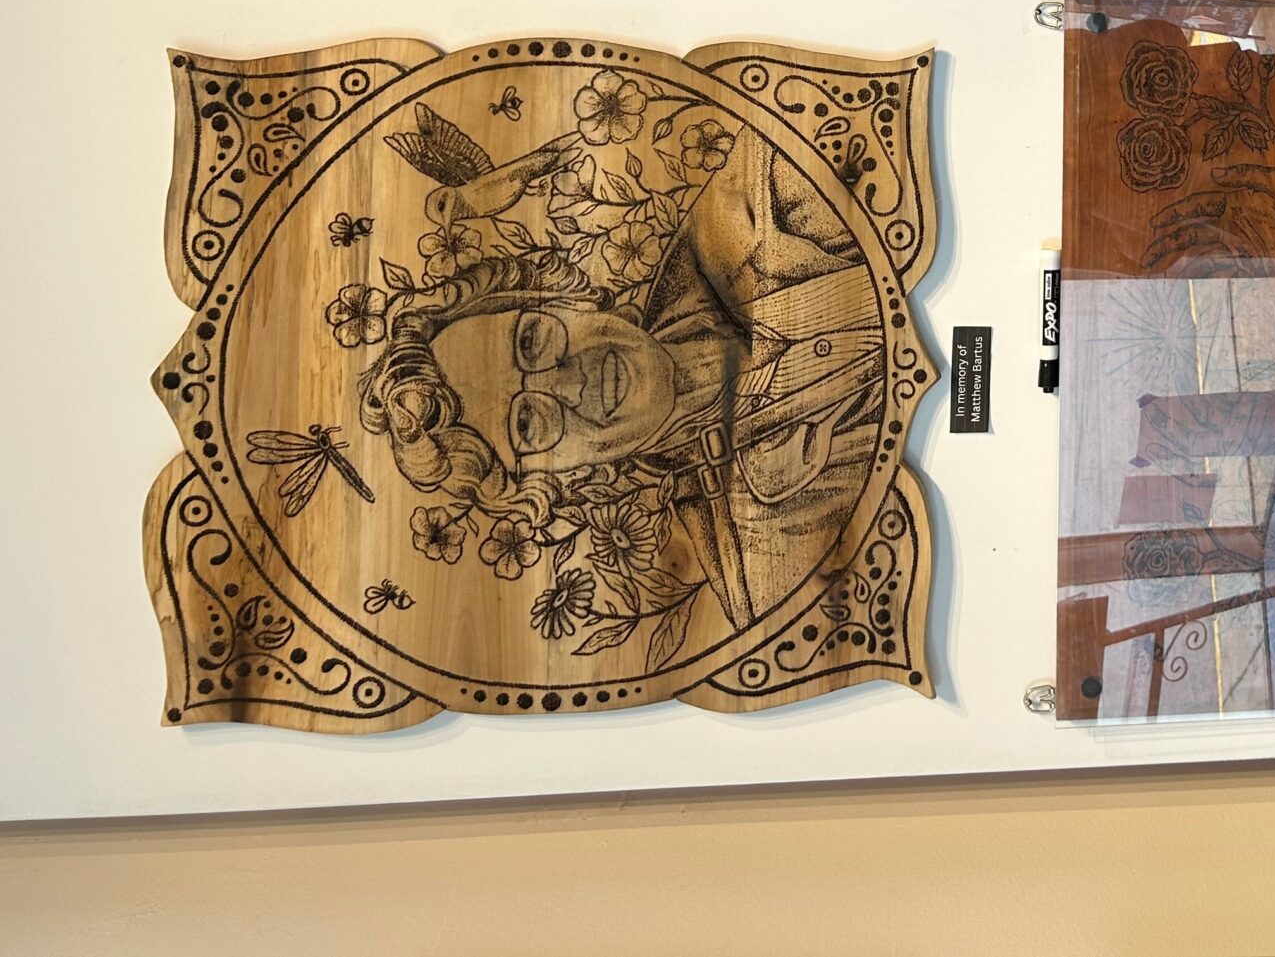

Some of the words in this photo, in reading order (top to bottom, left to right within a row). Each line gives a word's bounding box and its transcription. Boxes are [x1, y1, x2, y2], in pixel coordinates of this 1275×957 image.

[1045, 302, 1058, 342] EXPO
[957, 344, 967, 356] of
[973, 337, 982, 371] Bartus
[957, 360, 968, 403] memory
[971, 375, 982, 422] Matthew
[956, 407, 965, 416] In
